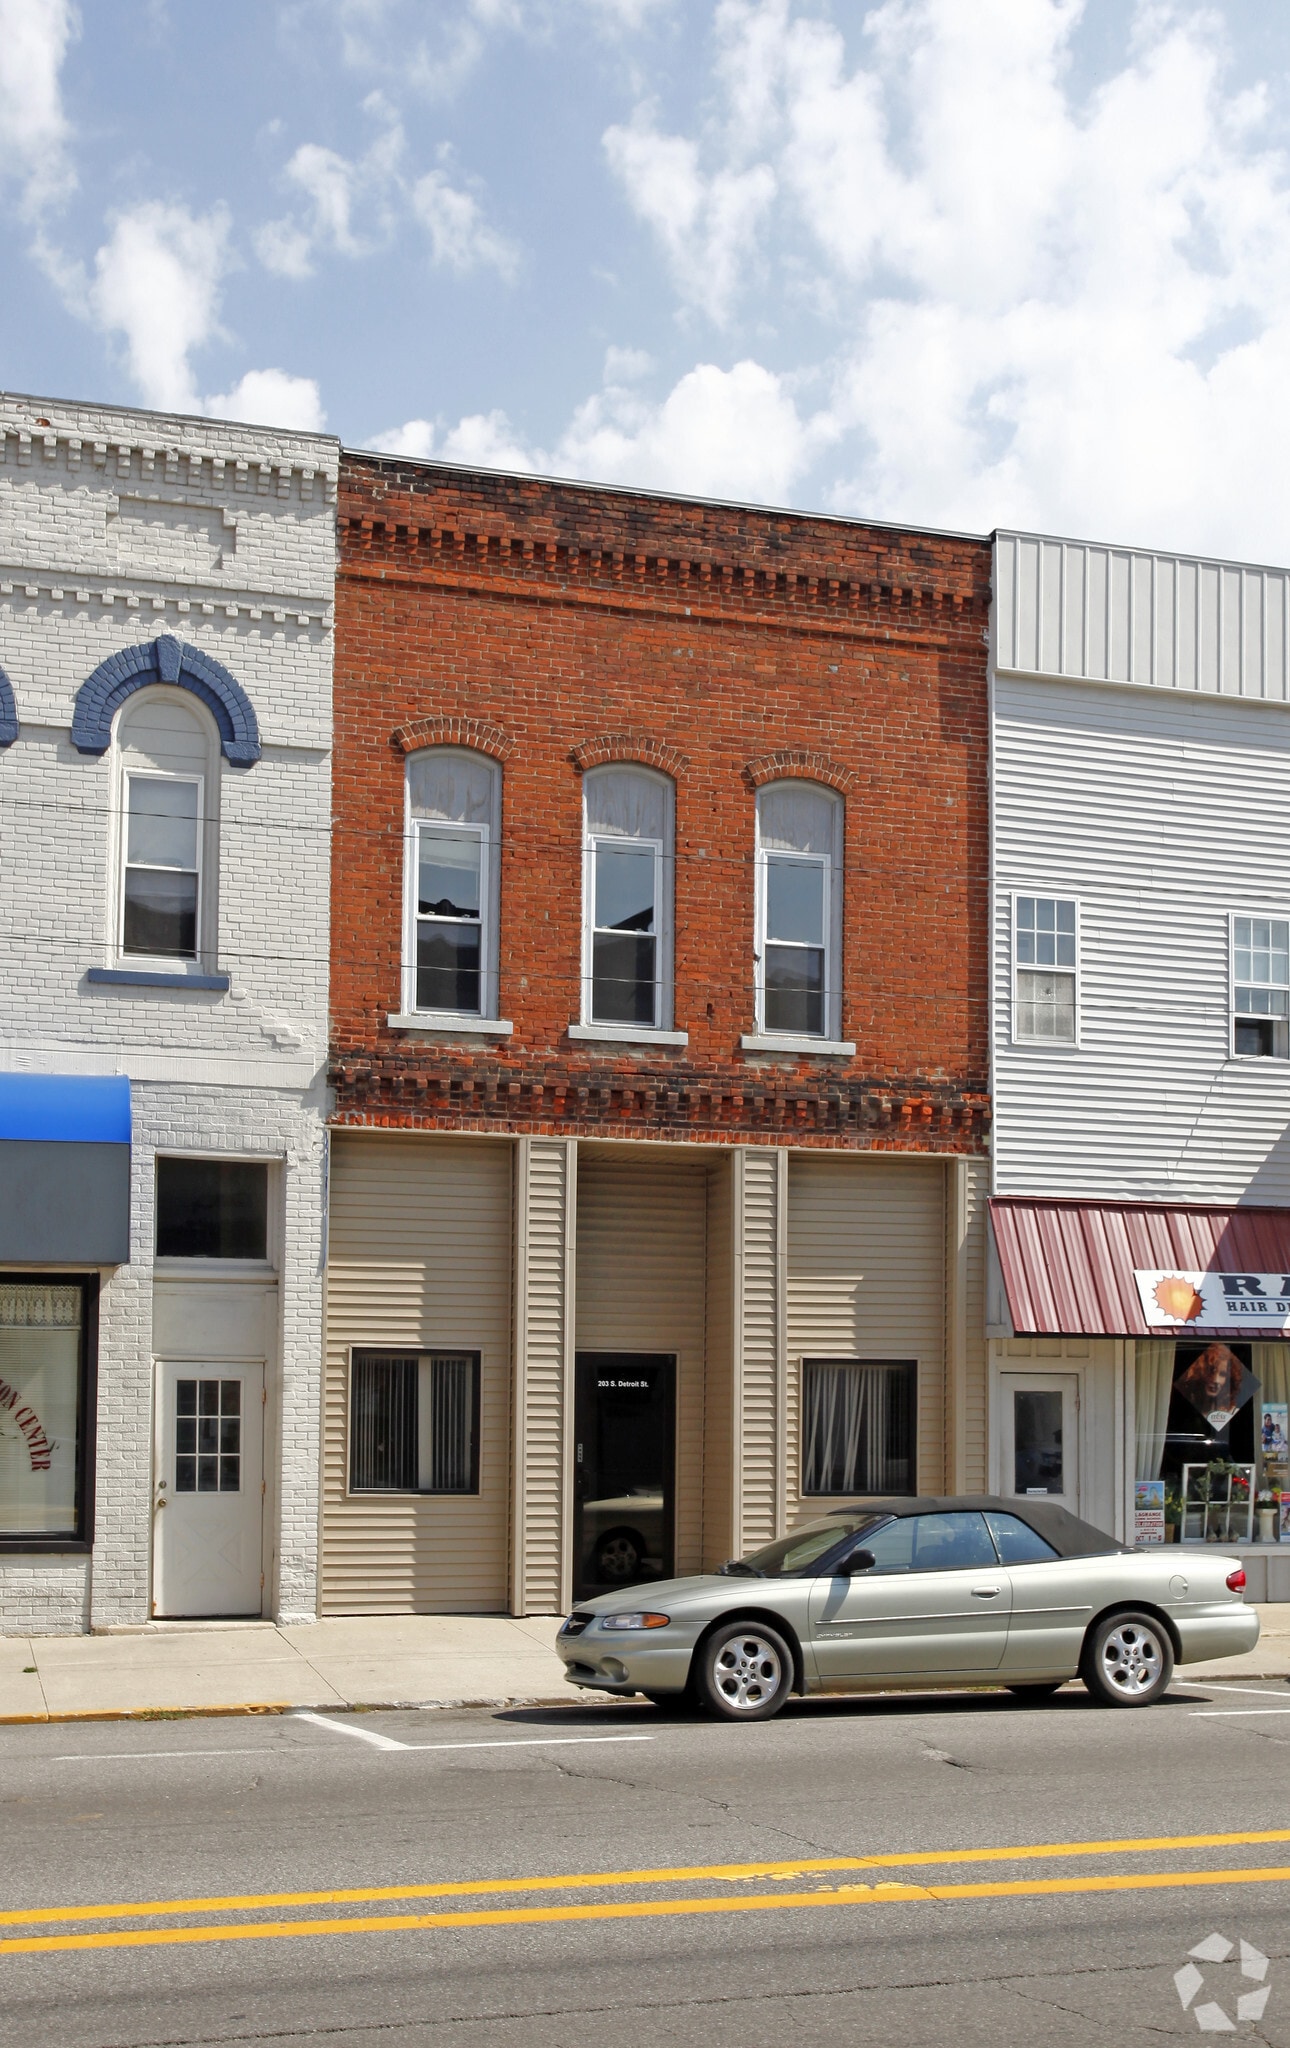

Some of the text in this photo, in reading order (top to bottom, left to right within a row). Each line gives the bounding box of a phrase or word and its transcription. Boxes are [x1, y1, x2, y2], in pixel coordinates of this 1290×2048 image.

[1218, 1275, 1290, 1297] R
[1225, 1301, 1268, 1312] HAIR
[618, 1380, 640, 1388] Detroit
[14, 1407, 51, 1472] CENTER
